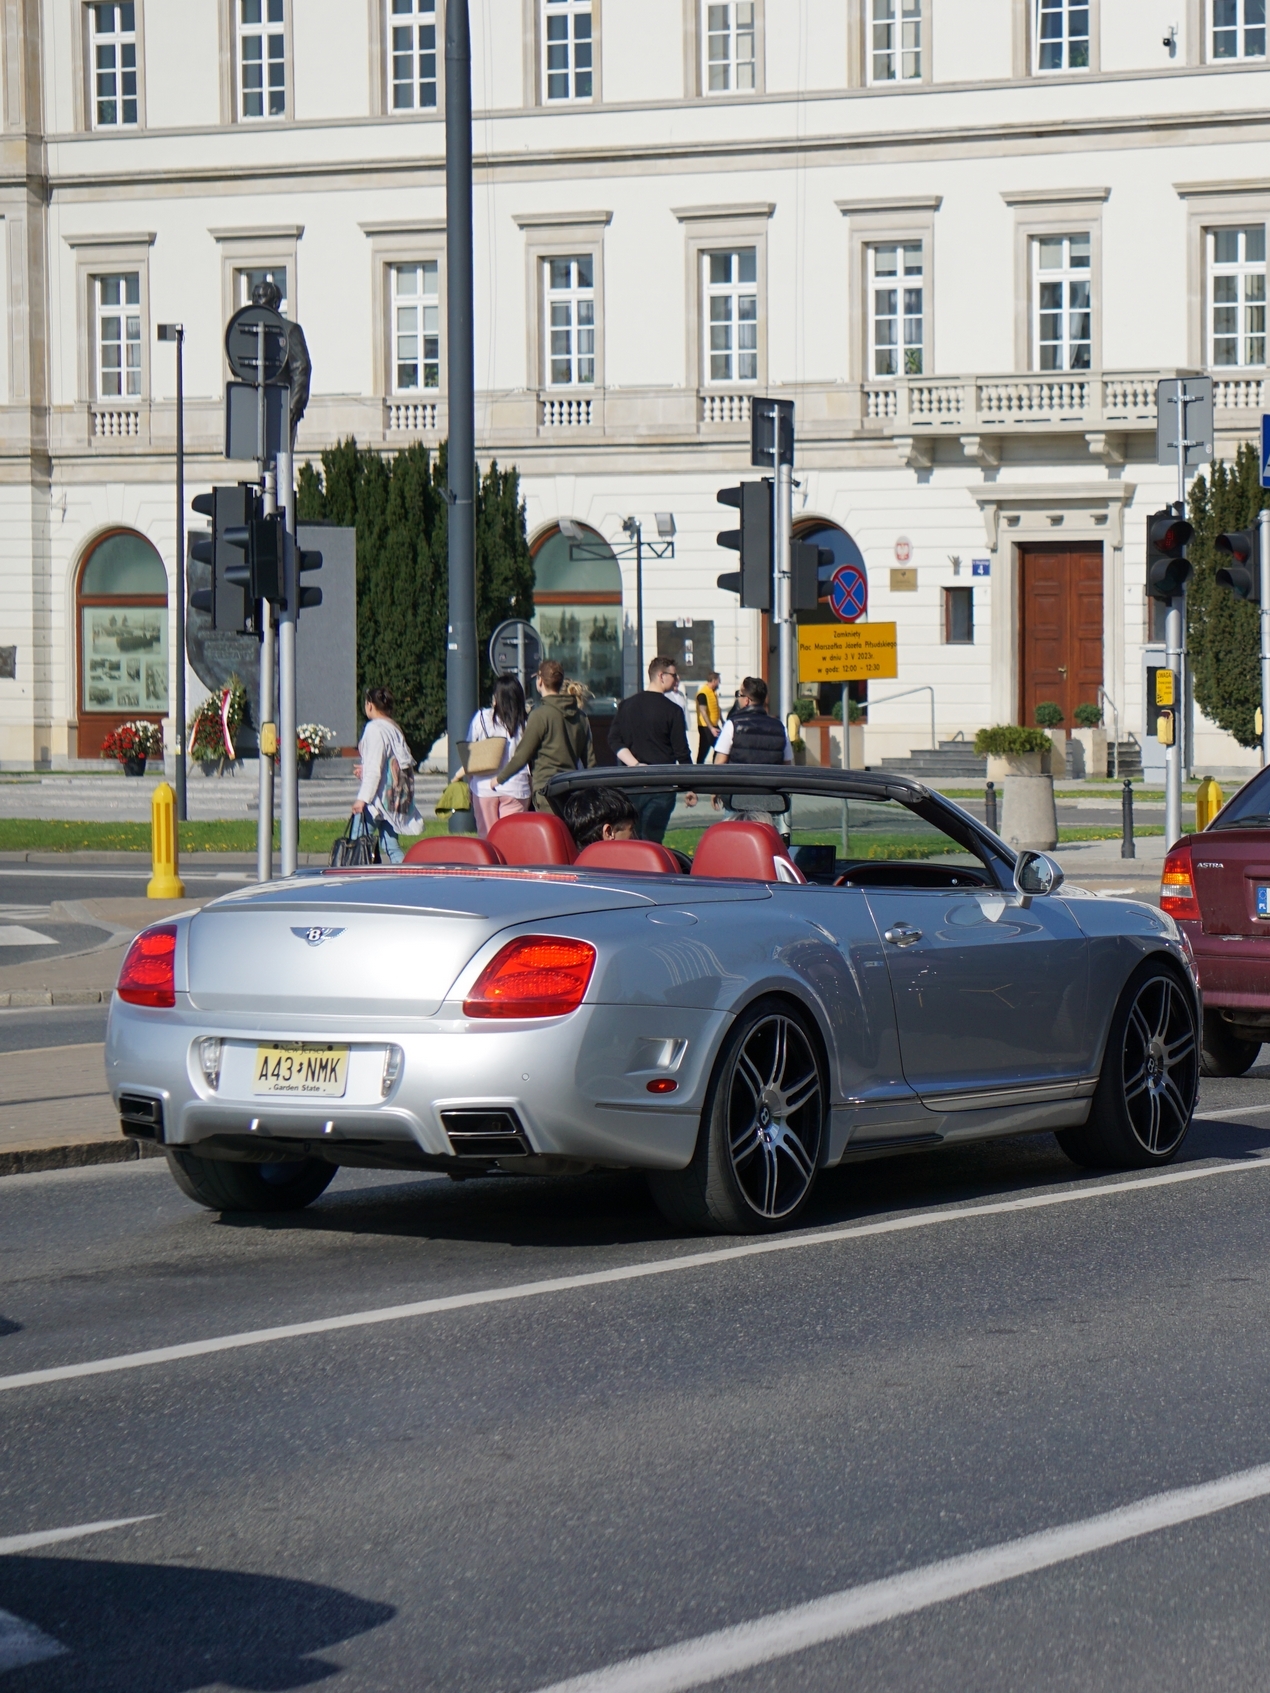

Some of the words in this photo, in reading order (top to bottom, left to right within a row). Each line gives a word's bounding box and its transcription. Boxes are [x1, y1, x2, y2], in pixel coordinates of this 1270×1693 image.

[977, 565, 984, 575] 4
[814, 642, 842, 650] Marszałka
[864, 640, 897, 649] Piłsudskiego
[842, 664, 858, 672] 12:00
[308, 930, 321, 940] B
[258, 1056, 294, 1082] A43
[304, 1057, 341, 1083] NMK
[273, 1084, 299, 1092] Garden
[302, 1084, 320, 1092] State
